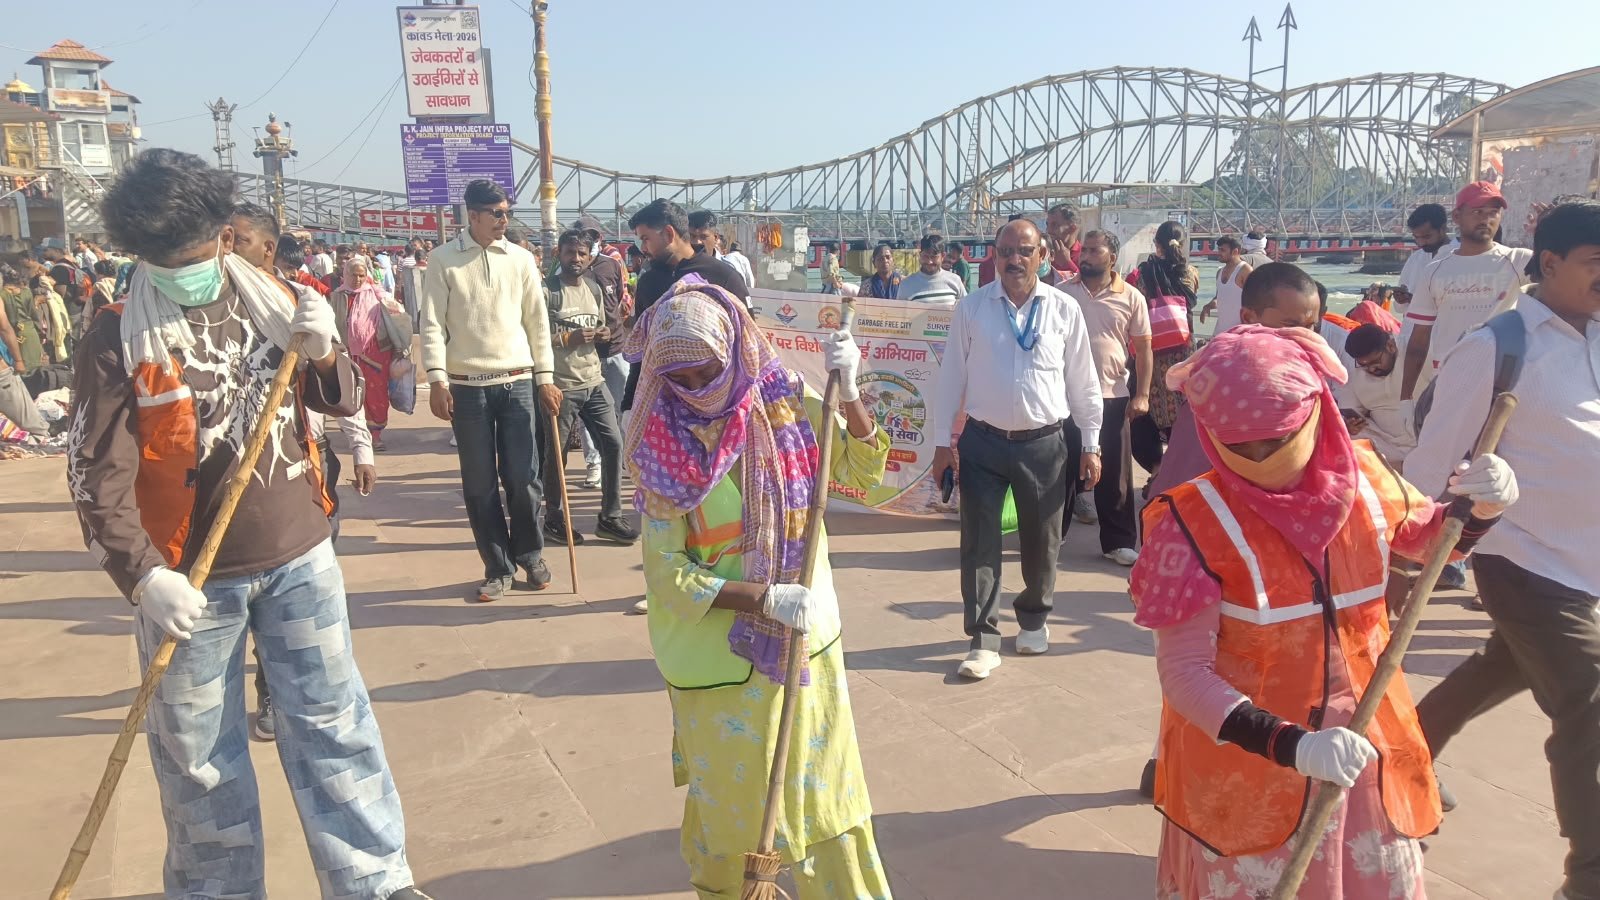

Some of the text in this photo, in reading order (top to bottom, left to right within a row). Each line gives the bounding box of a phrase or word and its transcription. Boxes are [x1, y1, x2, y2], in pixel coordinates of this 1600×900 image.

[467, 68, 479, 86] से
[425, 95, 471, 107] सावधान
[858, 319, 913, 329] GARBAGE FREE CITY
[927, 315, 952, 323] SWAC
[926, 323, 951, 331] SURVE
[776, 337, 793, 350] पर
[795, 335, 825, 353] विशे
[872, 342, 928, 362] अभियान
